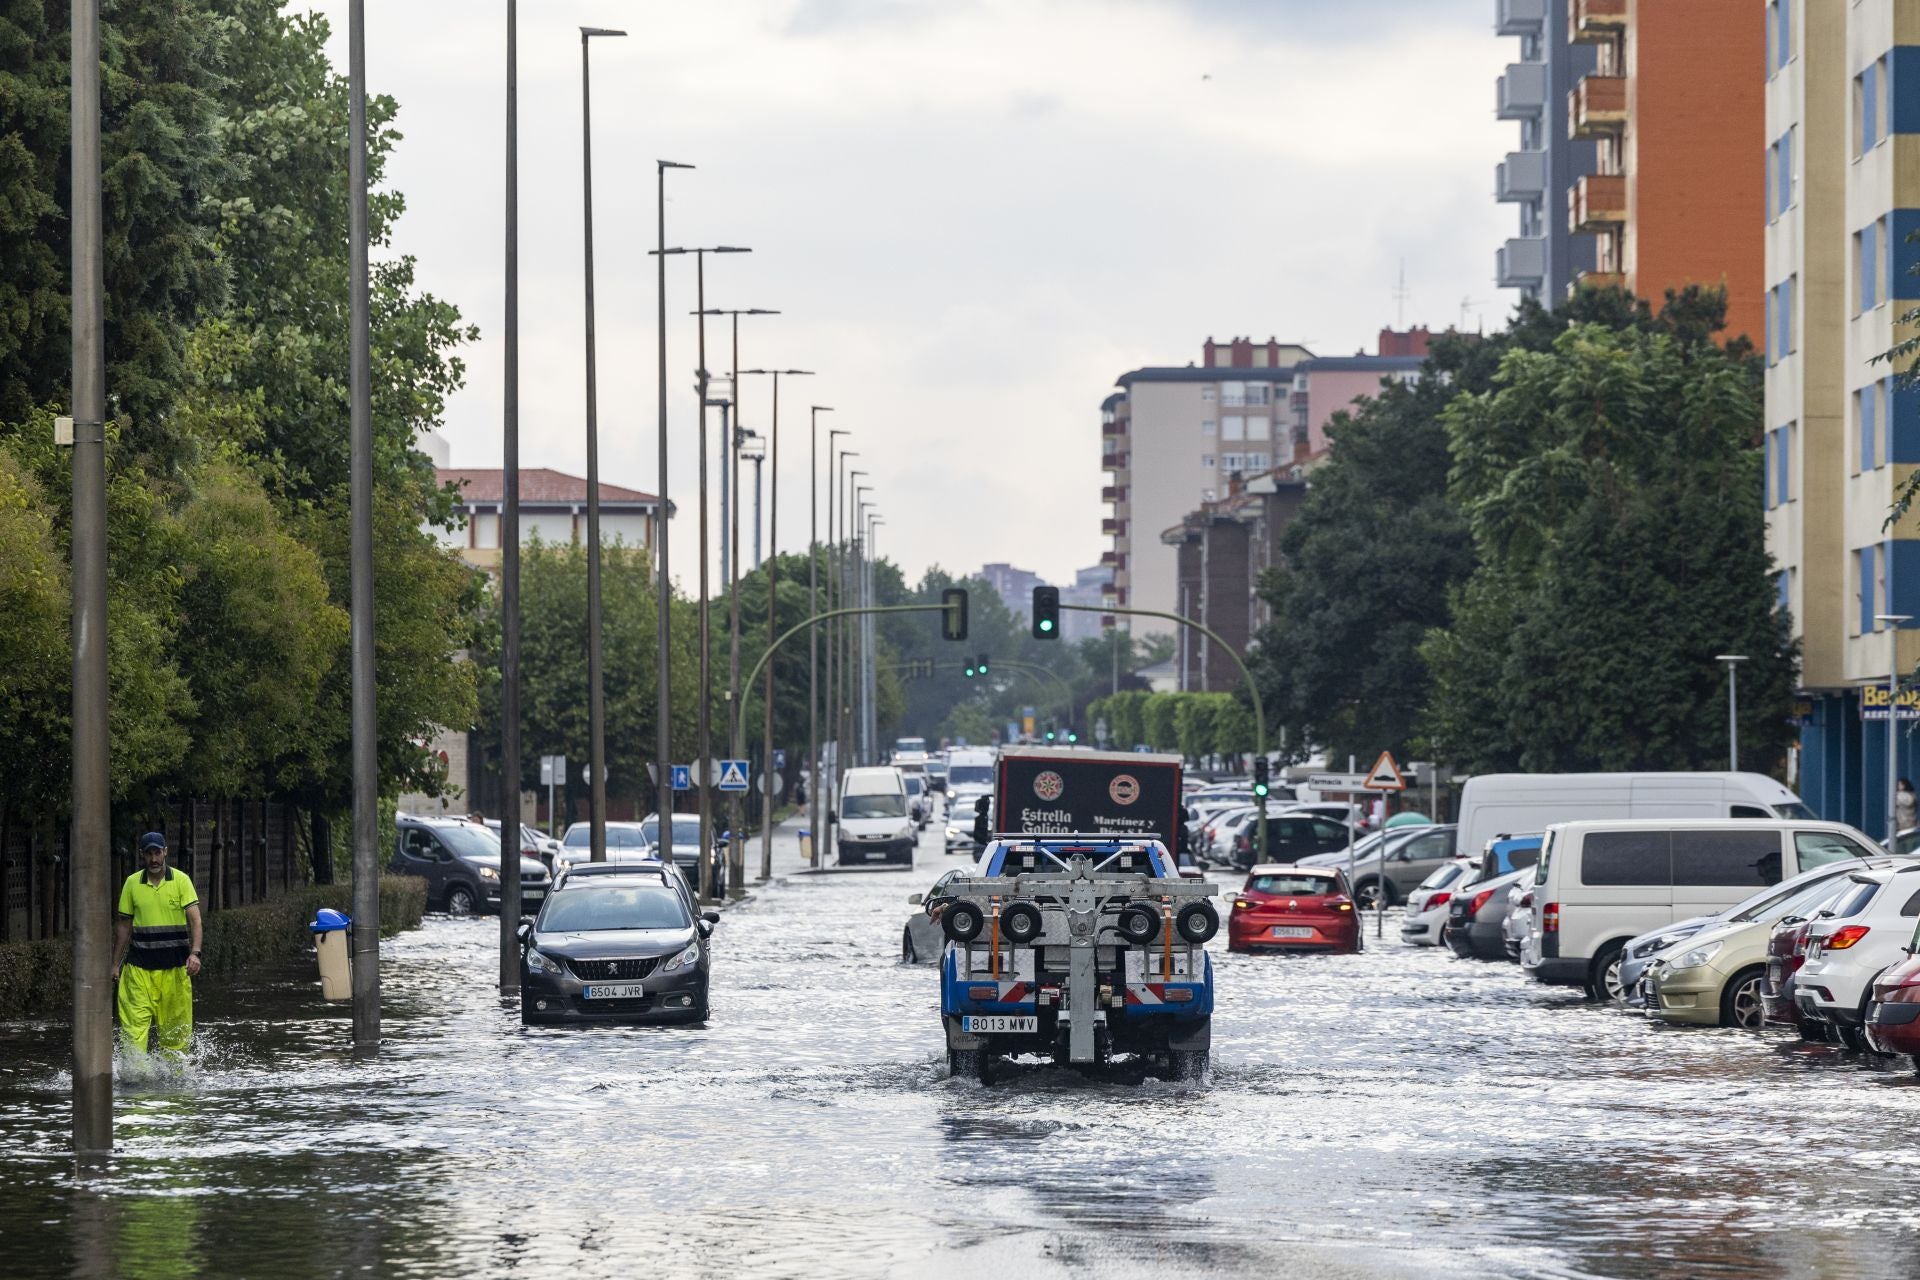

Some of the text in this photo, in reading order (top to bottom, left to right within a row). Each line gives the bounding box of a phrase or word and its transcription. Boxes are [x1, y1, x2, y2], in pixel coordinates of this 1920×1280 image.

[1020, 808, 1072, 823] Estrella
[1093, 815, 1156, 829] Martínez y
[591, 986, 641, 997] 6504 JVR
[972, 1018, 1034, 1031] 8013 MWV
